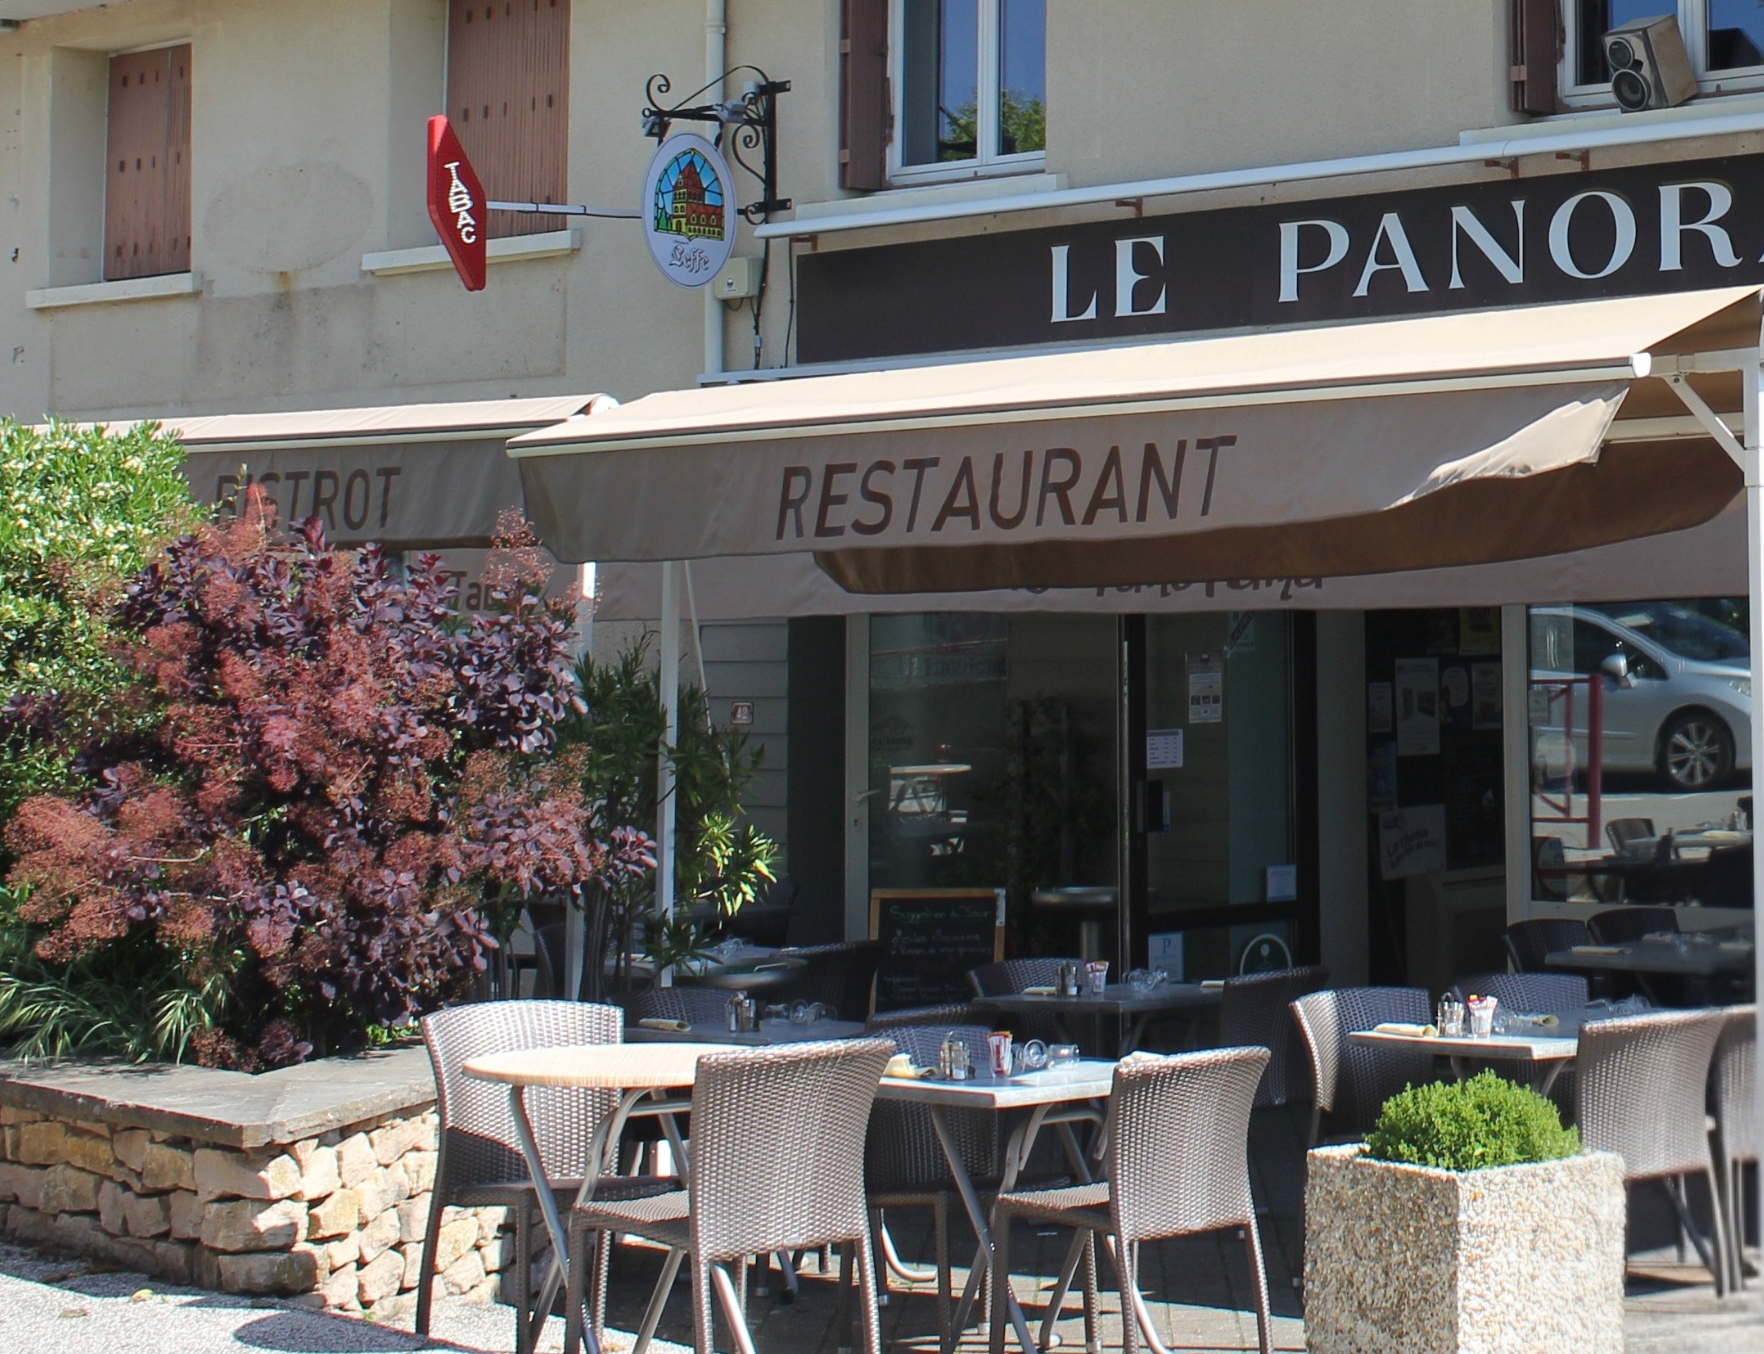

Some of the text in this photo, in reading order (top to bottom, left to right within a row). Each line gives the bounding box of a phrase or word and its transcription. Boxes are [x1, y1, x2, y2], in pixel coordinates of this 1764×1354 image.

[443, 160, 477, 244] TABAC
[668, 245, 710, 274] Leffe
[1050, 235, 1167, 324] LE
[775, 434, 1238, 541] RESTAURANT
